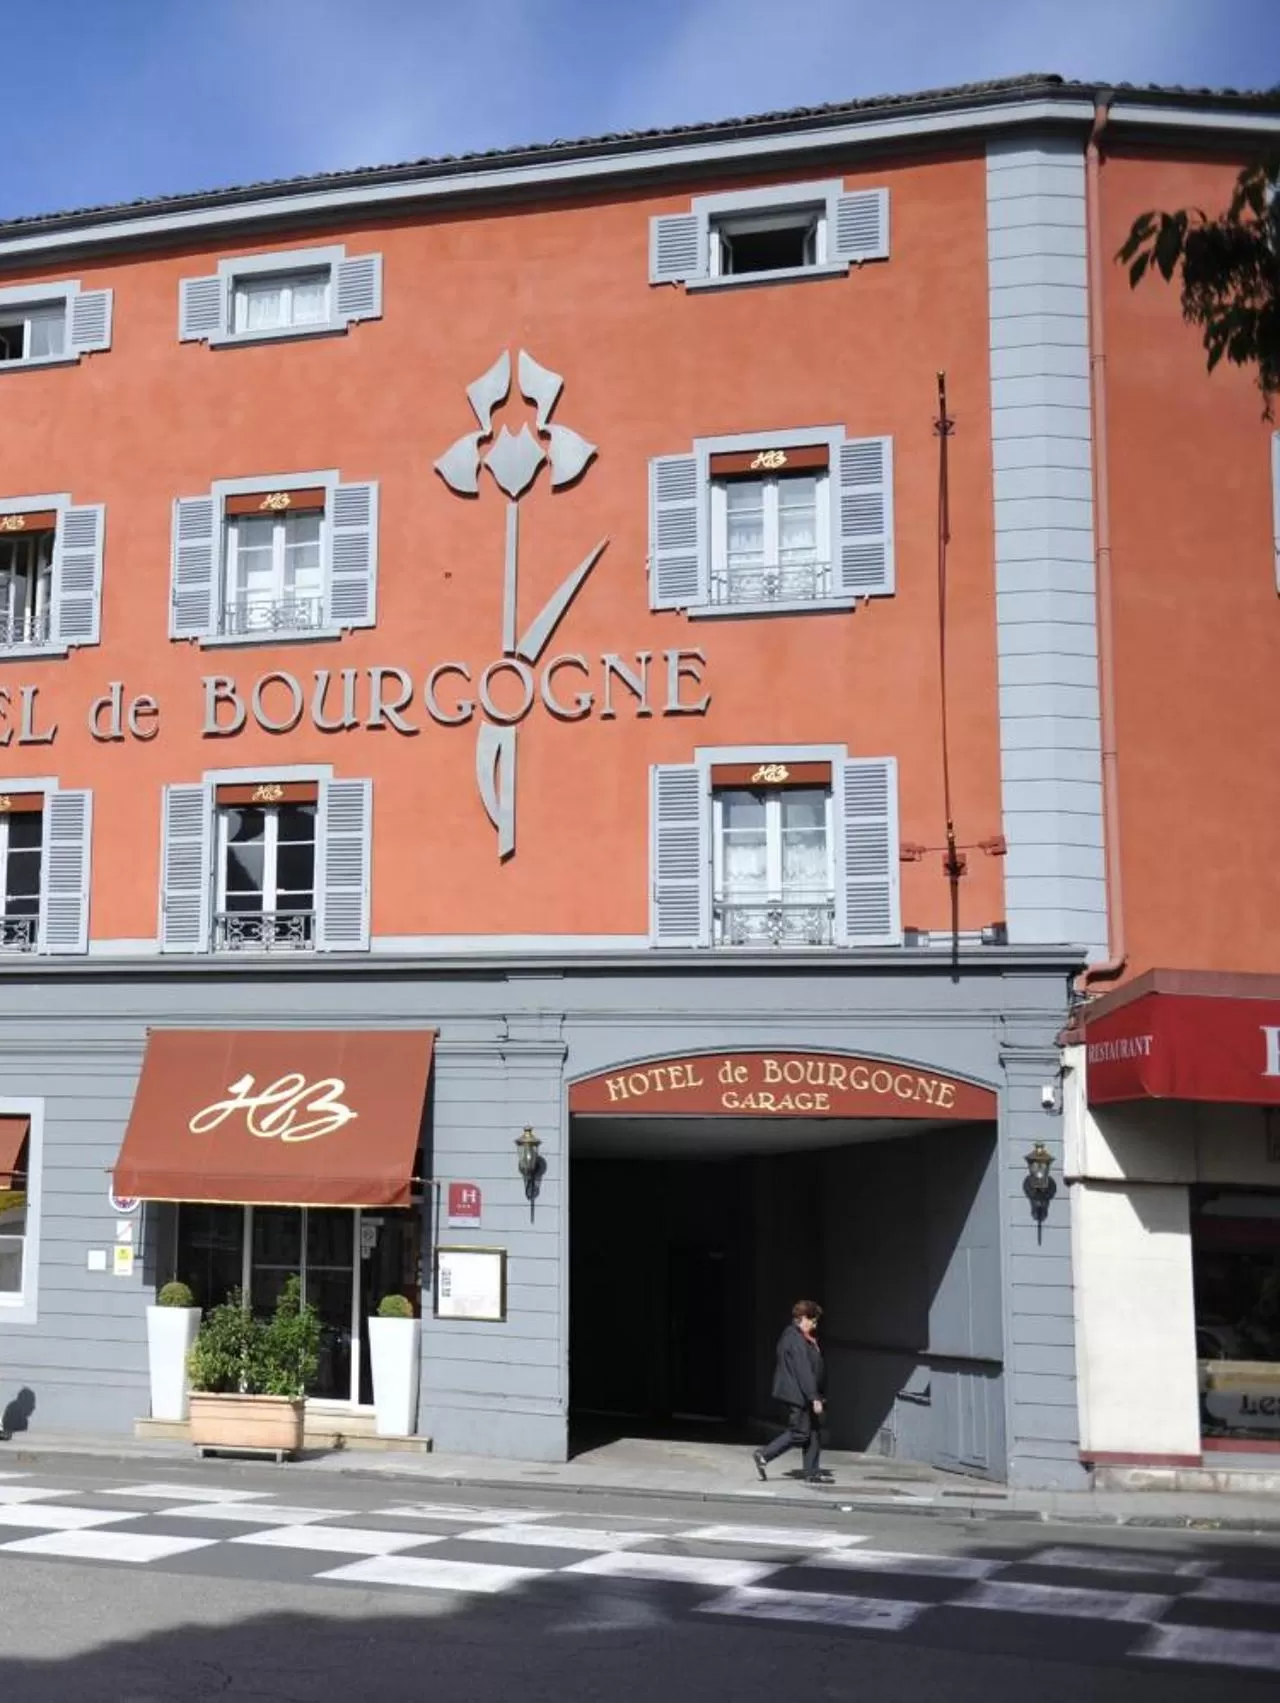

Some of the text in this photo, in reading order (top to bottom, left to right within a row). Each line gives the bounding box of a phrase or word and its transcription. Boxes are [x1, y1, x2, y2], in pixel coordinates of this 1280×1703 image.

[88, 682, 160, 741] de
[200, 648, 712, 739] BOURGOGNE
[1088, 1035, 1154, 1065] RESTAURANT
[605, 1058, 957, 1109] HOTEL de BOURGOGNE
[721, 1091, 830, 1112] GARAGE
[461, 1188, 477, 1203] H
